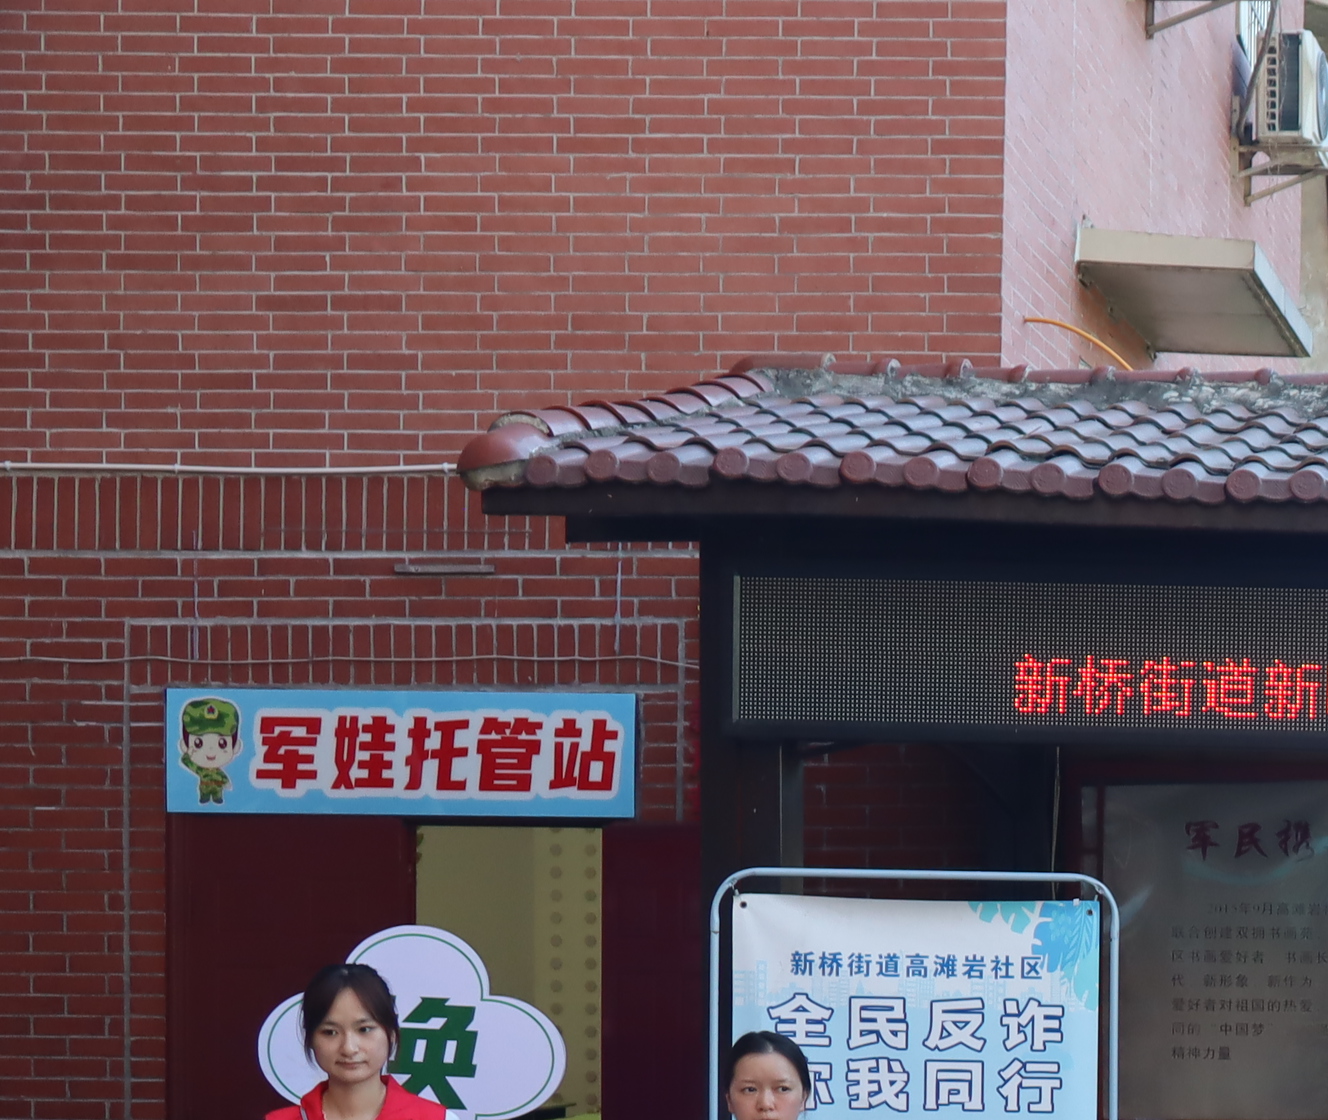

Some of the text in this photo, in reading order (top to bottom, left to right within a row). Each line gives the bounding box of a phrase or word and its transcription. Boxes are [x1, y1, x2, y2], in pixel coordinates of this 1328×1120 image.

[255, 714, 619, 793] 军娃托管站
[789, 950, 1044, 980] 新桥街道高滩岩社区
[767, 993, 1065, 1052] 全民反诈
